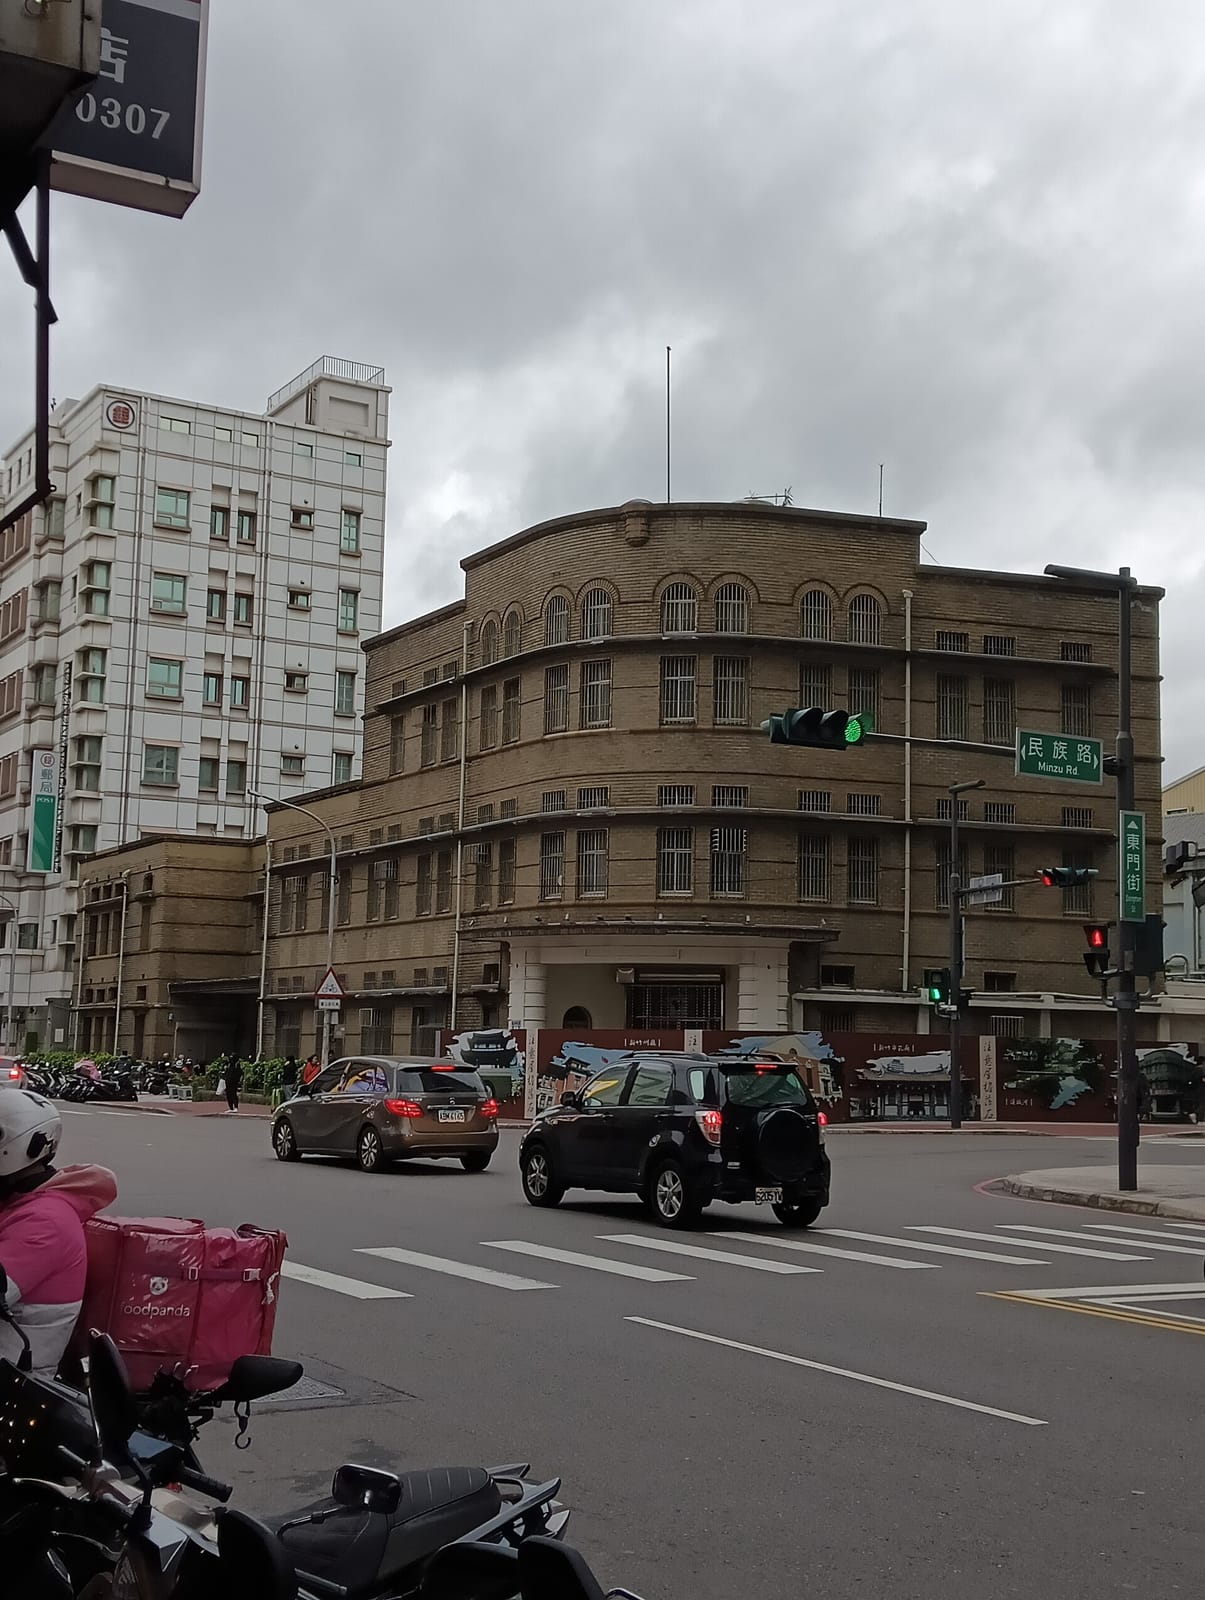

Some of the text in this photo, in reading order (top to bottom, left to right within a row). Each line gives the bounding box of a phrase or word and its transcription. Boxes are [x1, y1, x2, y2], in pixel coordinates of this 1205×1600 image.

[75, 92, 171, 140] 0307
[1027, 736, 1093, 764] 民族路
[40, 768, 53, 793] 郵局
[1037, 761, 1080, 776] Minzu Rd.
[1126, 833, 1141, 892] 東門街
[120, 1302, 191, 1319] foodpanda
